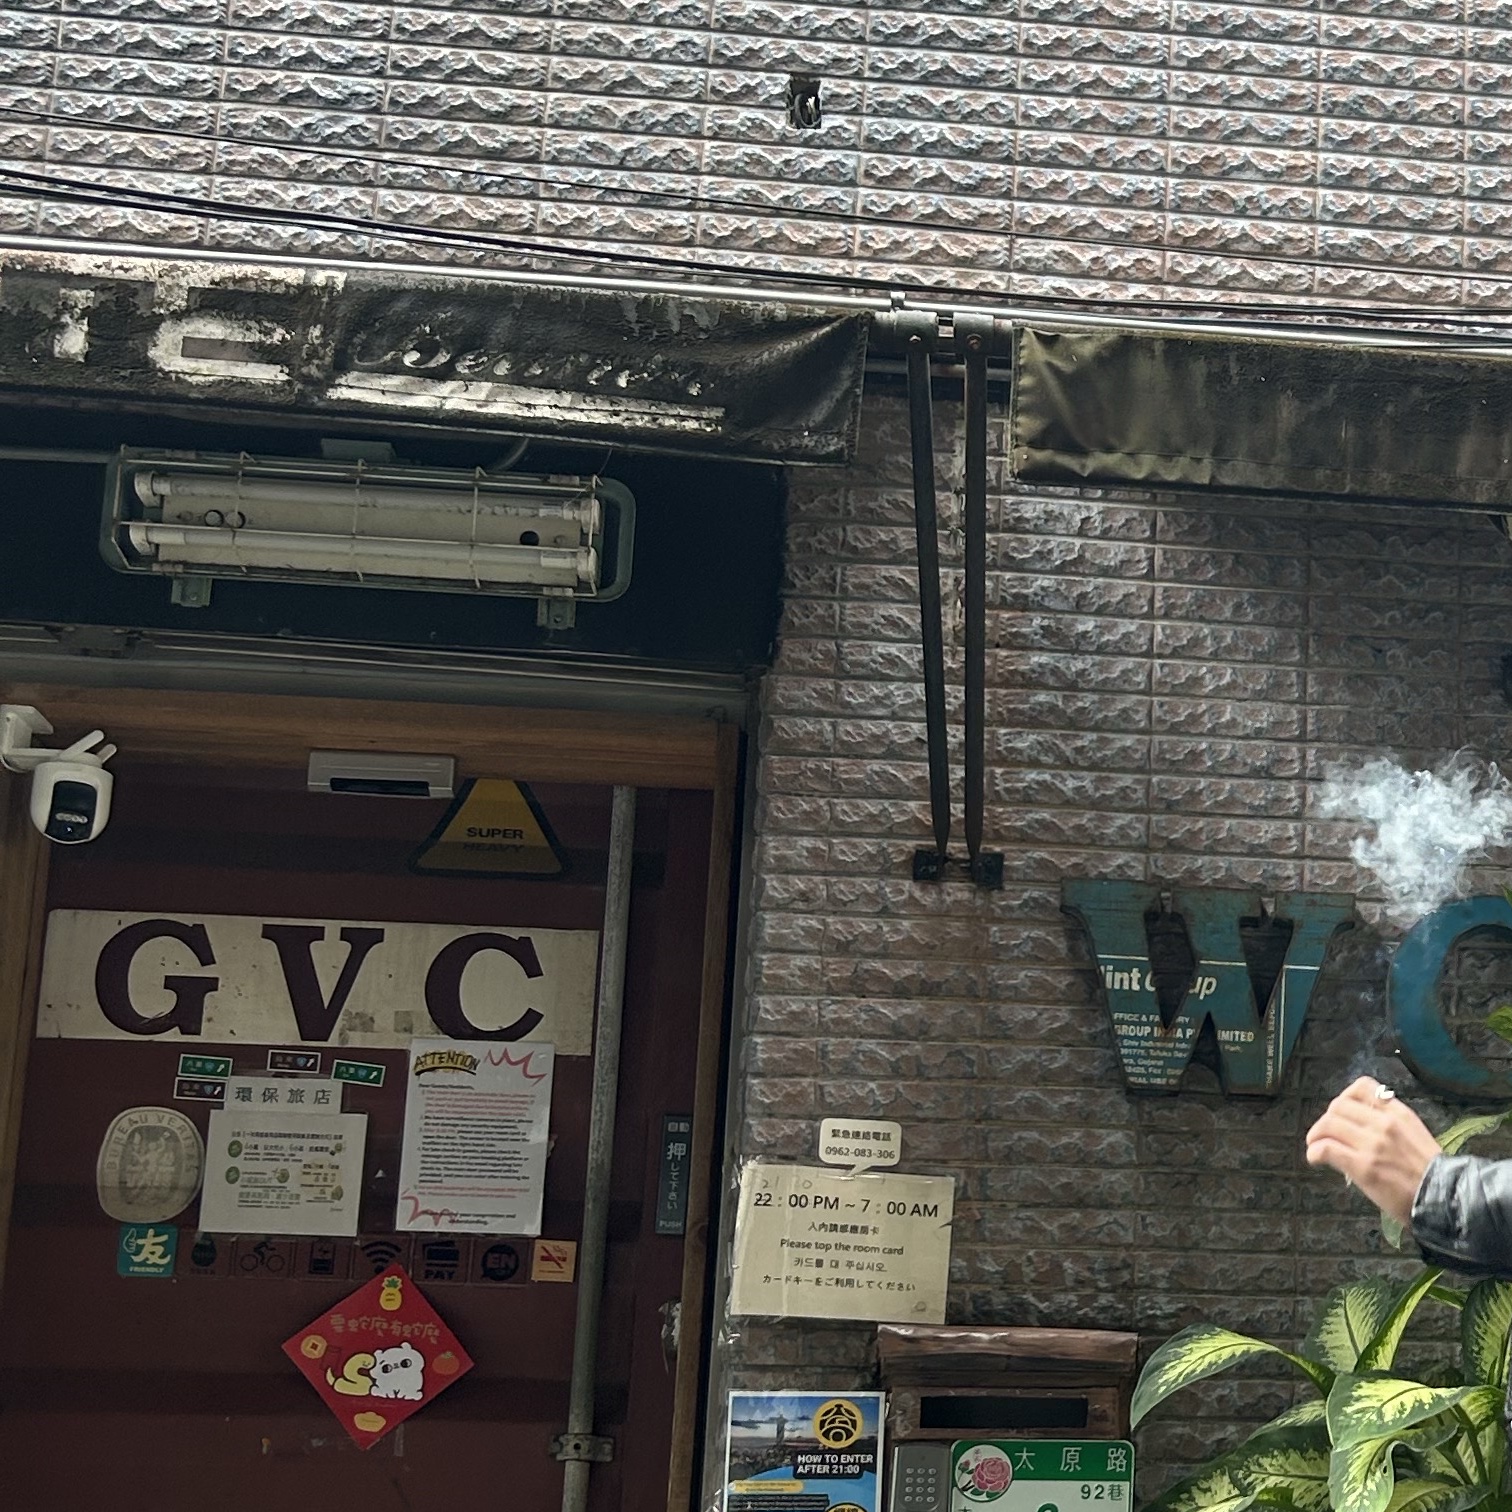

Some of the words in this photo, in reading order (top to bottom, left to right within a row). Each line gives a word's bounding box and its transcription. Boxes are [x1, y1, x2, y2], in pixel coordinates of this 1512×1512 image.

[466, 826, 524, 839] SUPER
[95, 919, 546, 1043] GVC
[414, 1050, 481, 1072] ATTENTION
[235, 1086, 332, 1105] 環保旅店
[824, 1145, 895, 1160] 0962-083-306
[666, 1142, 687, 1209] 押して下さい
[812, 1195, 840, 1210] PM
[910, 1203, 939, 1218] AM
[659, 1220, 682, 1228] PUSH
[130, 1228, 171, 1265] 友
[780, 1238, 812, 1249] Please
[814, 1240, 832, 1252] top
[834, 1241, 850, 1252] the
[853, 1244, 880, 1254] room
[882, 1245, 904, 1255] card
[129, 1266, 165, 1274] FRIENDLY
[424, 1269, 456, 1281] PAY
[797, 1454, 823, 1464] HOW
[824, 1454, 839, 1463] TO
[840, 1454, 874, 1463] ENTER
[1014, 1446, 1128, 1473] 太原路
[796, 1464, 830, 1474] AFTER
[831, 1465, 860, 1475] 21:00
[1080, 1483, 1125, 1501] 92巷
